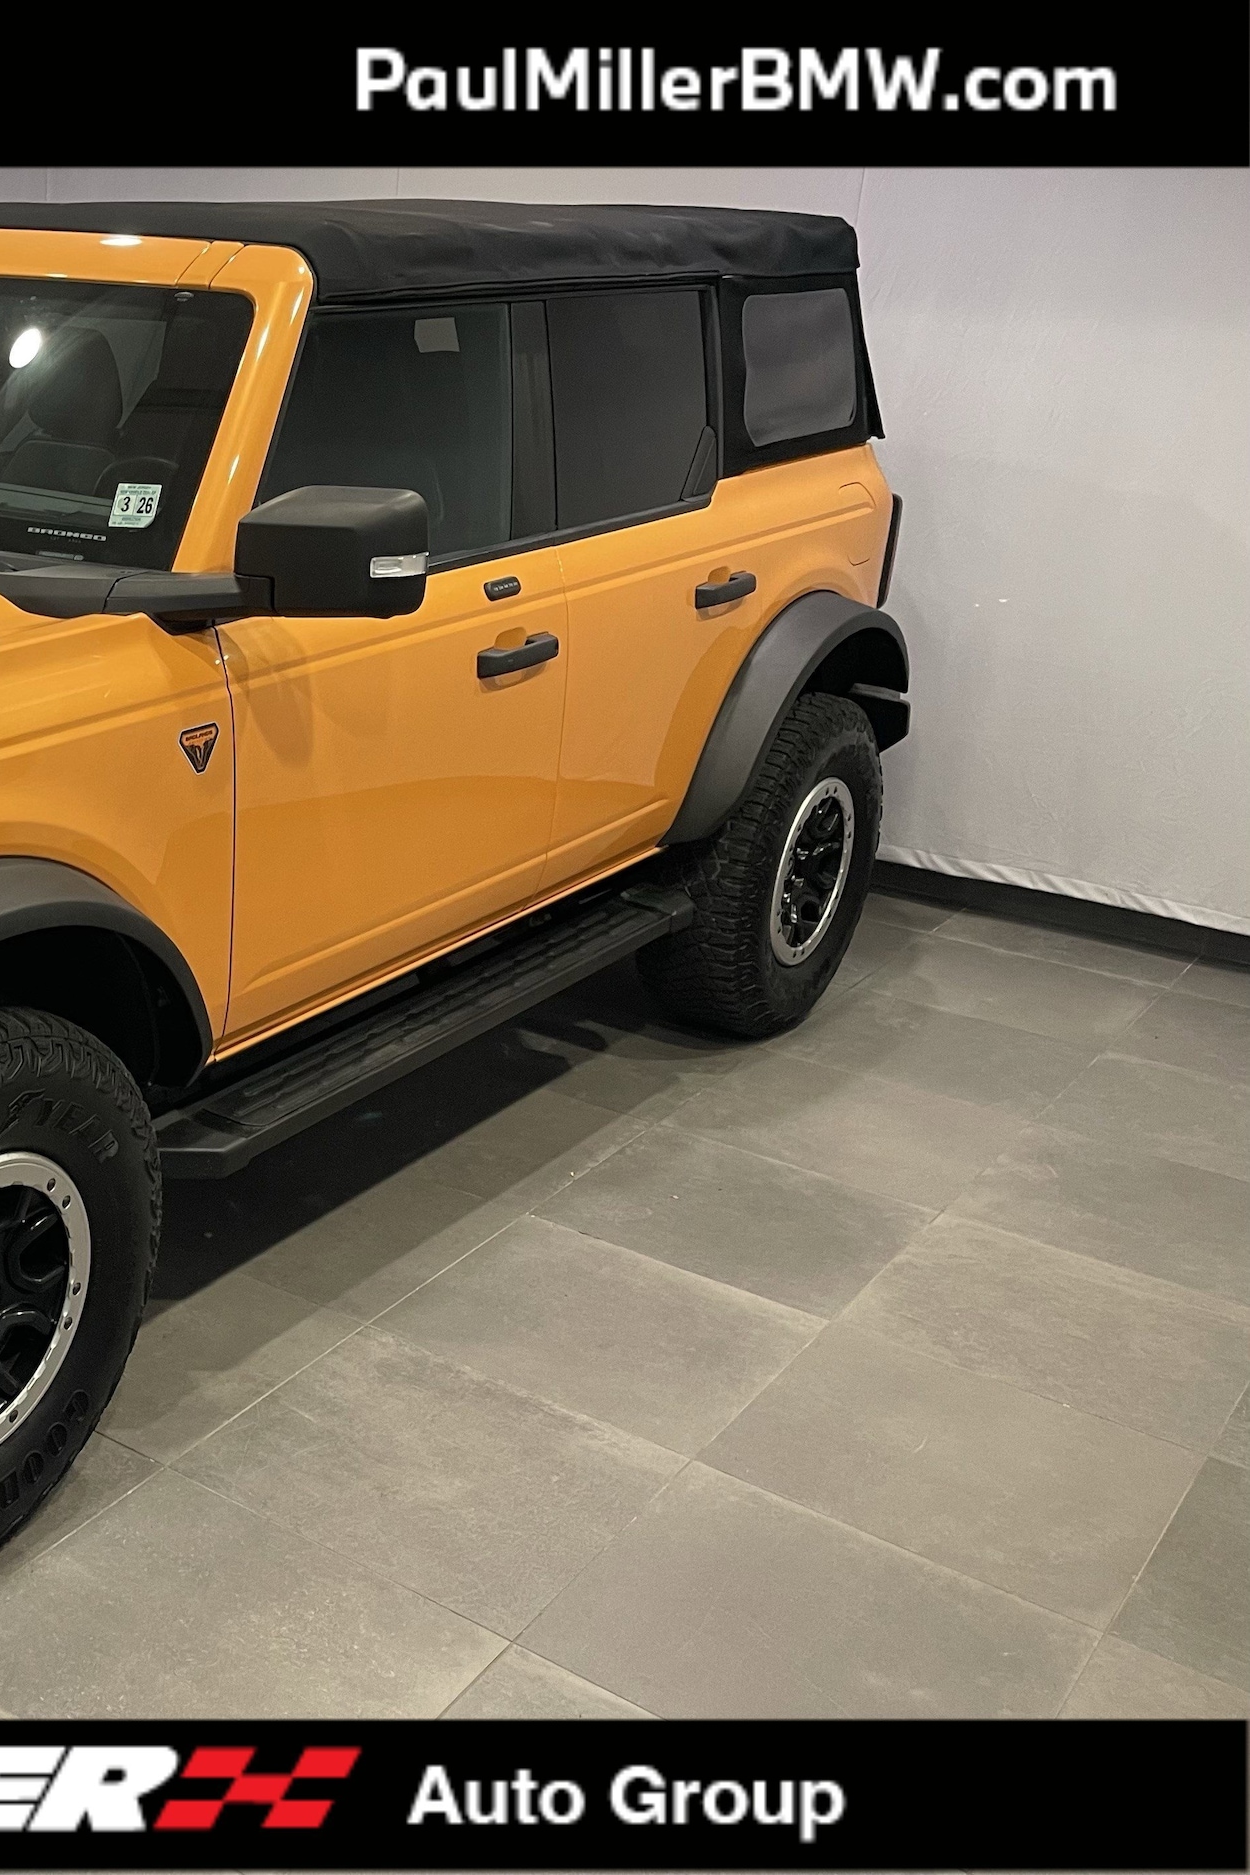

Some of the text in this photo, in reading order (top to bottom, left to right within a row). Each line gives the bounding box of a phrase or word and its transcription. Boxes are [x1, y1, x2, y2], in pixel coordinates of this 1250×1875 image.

[120, 496, 154, 514] 3 26
[27, 526, 107, 541] BRONCO
